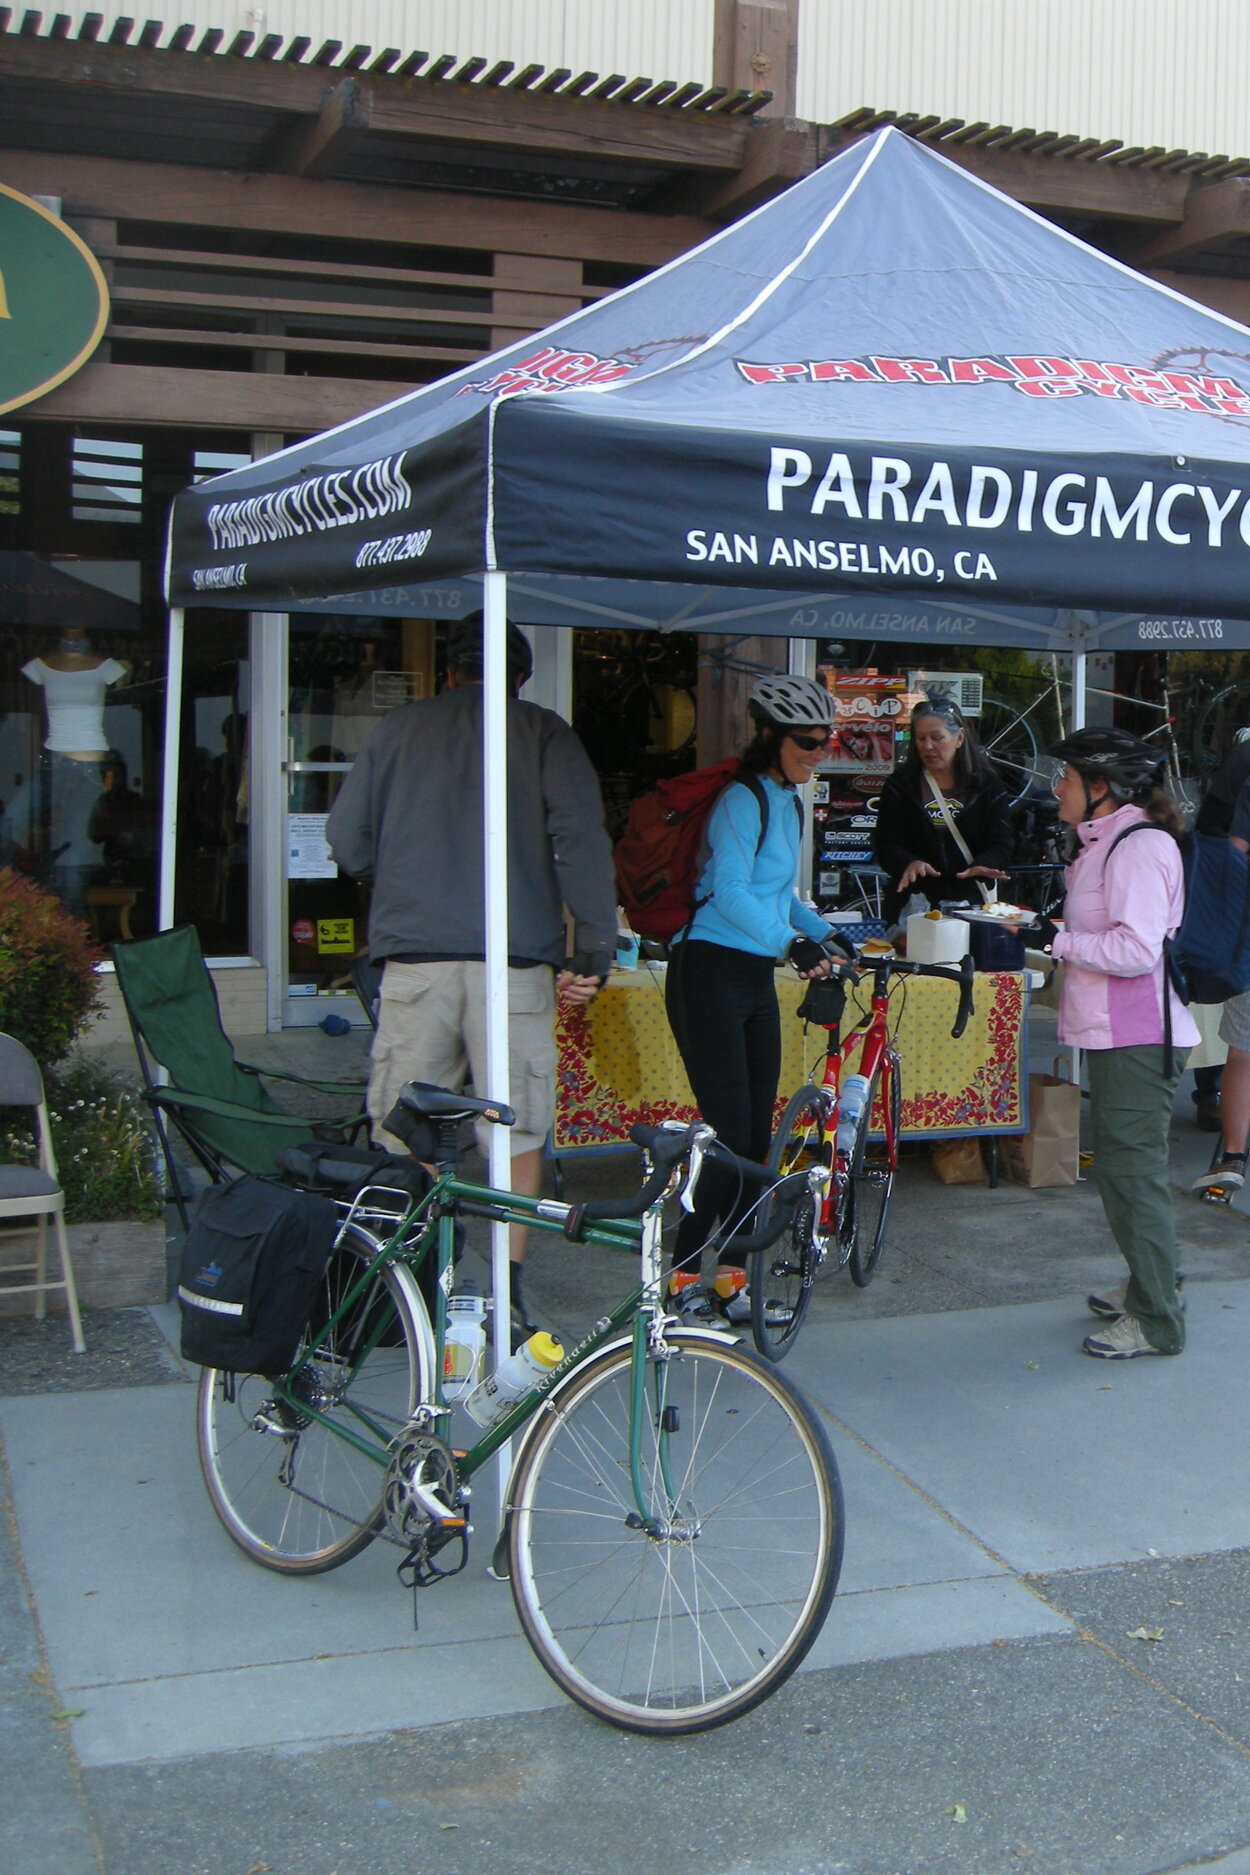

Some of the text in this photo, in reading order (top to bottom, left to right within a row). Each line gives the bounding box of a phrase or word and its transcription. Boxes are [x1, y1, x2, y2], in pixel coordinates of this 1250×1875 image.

[736, 354, 1249, 399] PARADIGM
[207, 451, 412, 549] PARADIGMCYCLES.COM
[356, 529, 433, 568] 877.437.2988
[686, 529, 998, 583] SAN ANSELMO, CA
[836, 676, 907, 686] ZIPP
[829, 720, 891, 733] ervélo
[836, 832, 871, 840] SCOTT
[824, 852, 872, 860] RITCHEY
[535, 1329, 599, 1393] Rivendell
